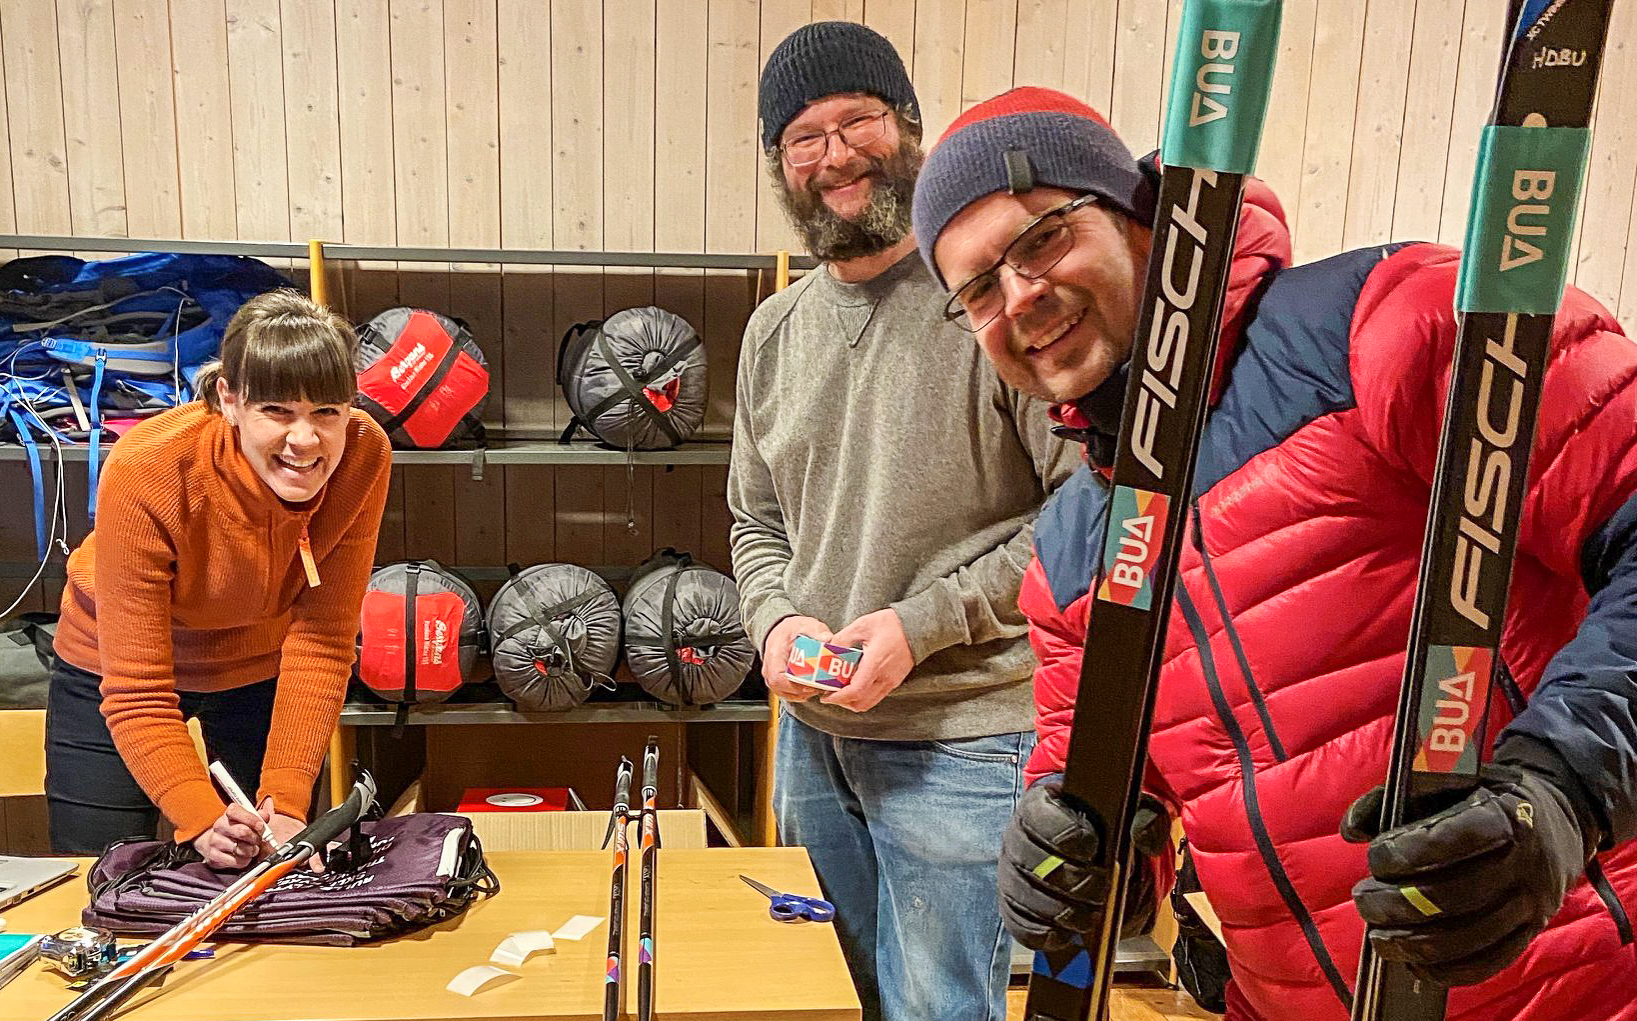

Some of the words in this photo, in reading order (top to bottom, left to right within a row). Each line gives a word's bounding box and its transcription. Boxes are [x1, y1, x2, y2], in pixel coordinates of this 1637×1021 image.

[1189, 29, 1241, 128] BUA
[1499, 169, 1556, 272] BUA
[1112, 514, 1155, 589] BUA
[790, 647, 805, 668] UA
[828, 657, 855, 679] BU
[1430, 670, 1477, 753] BUA
